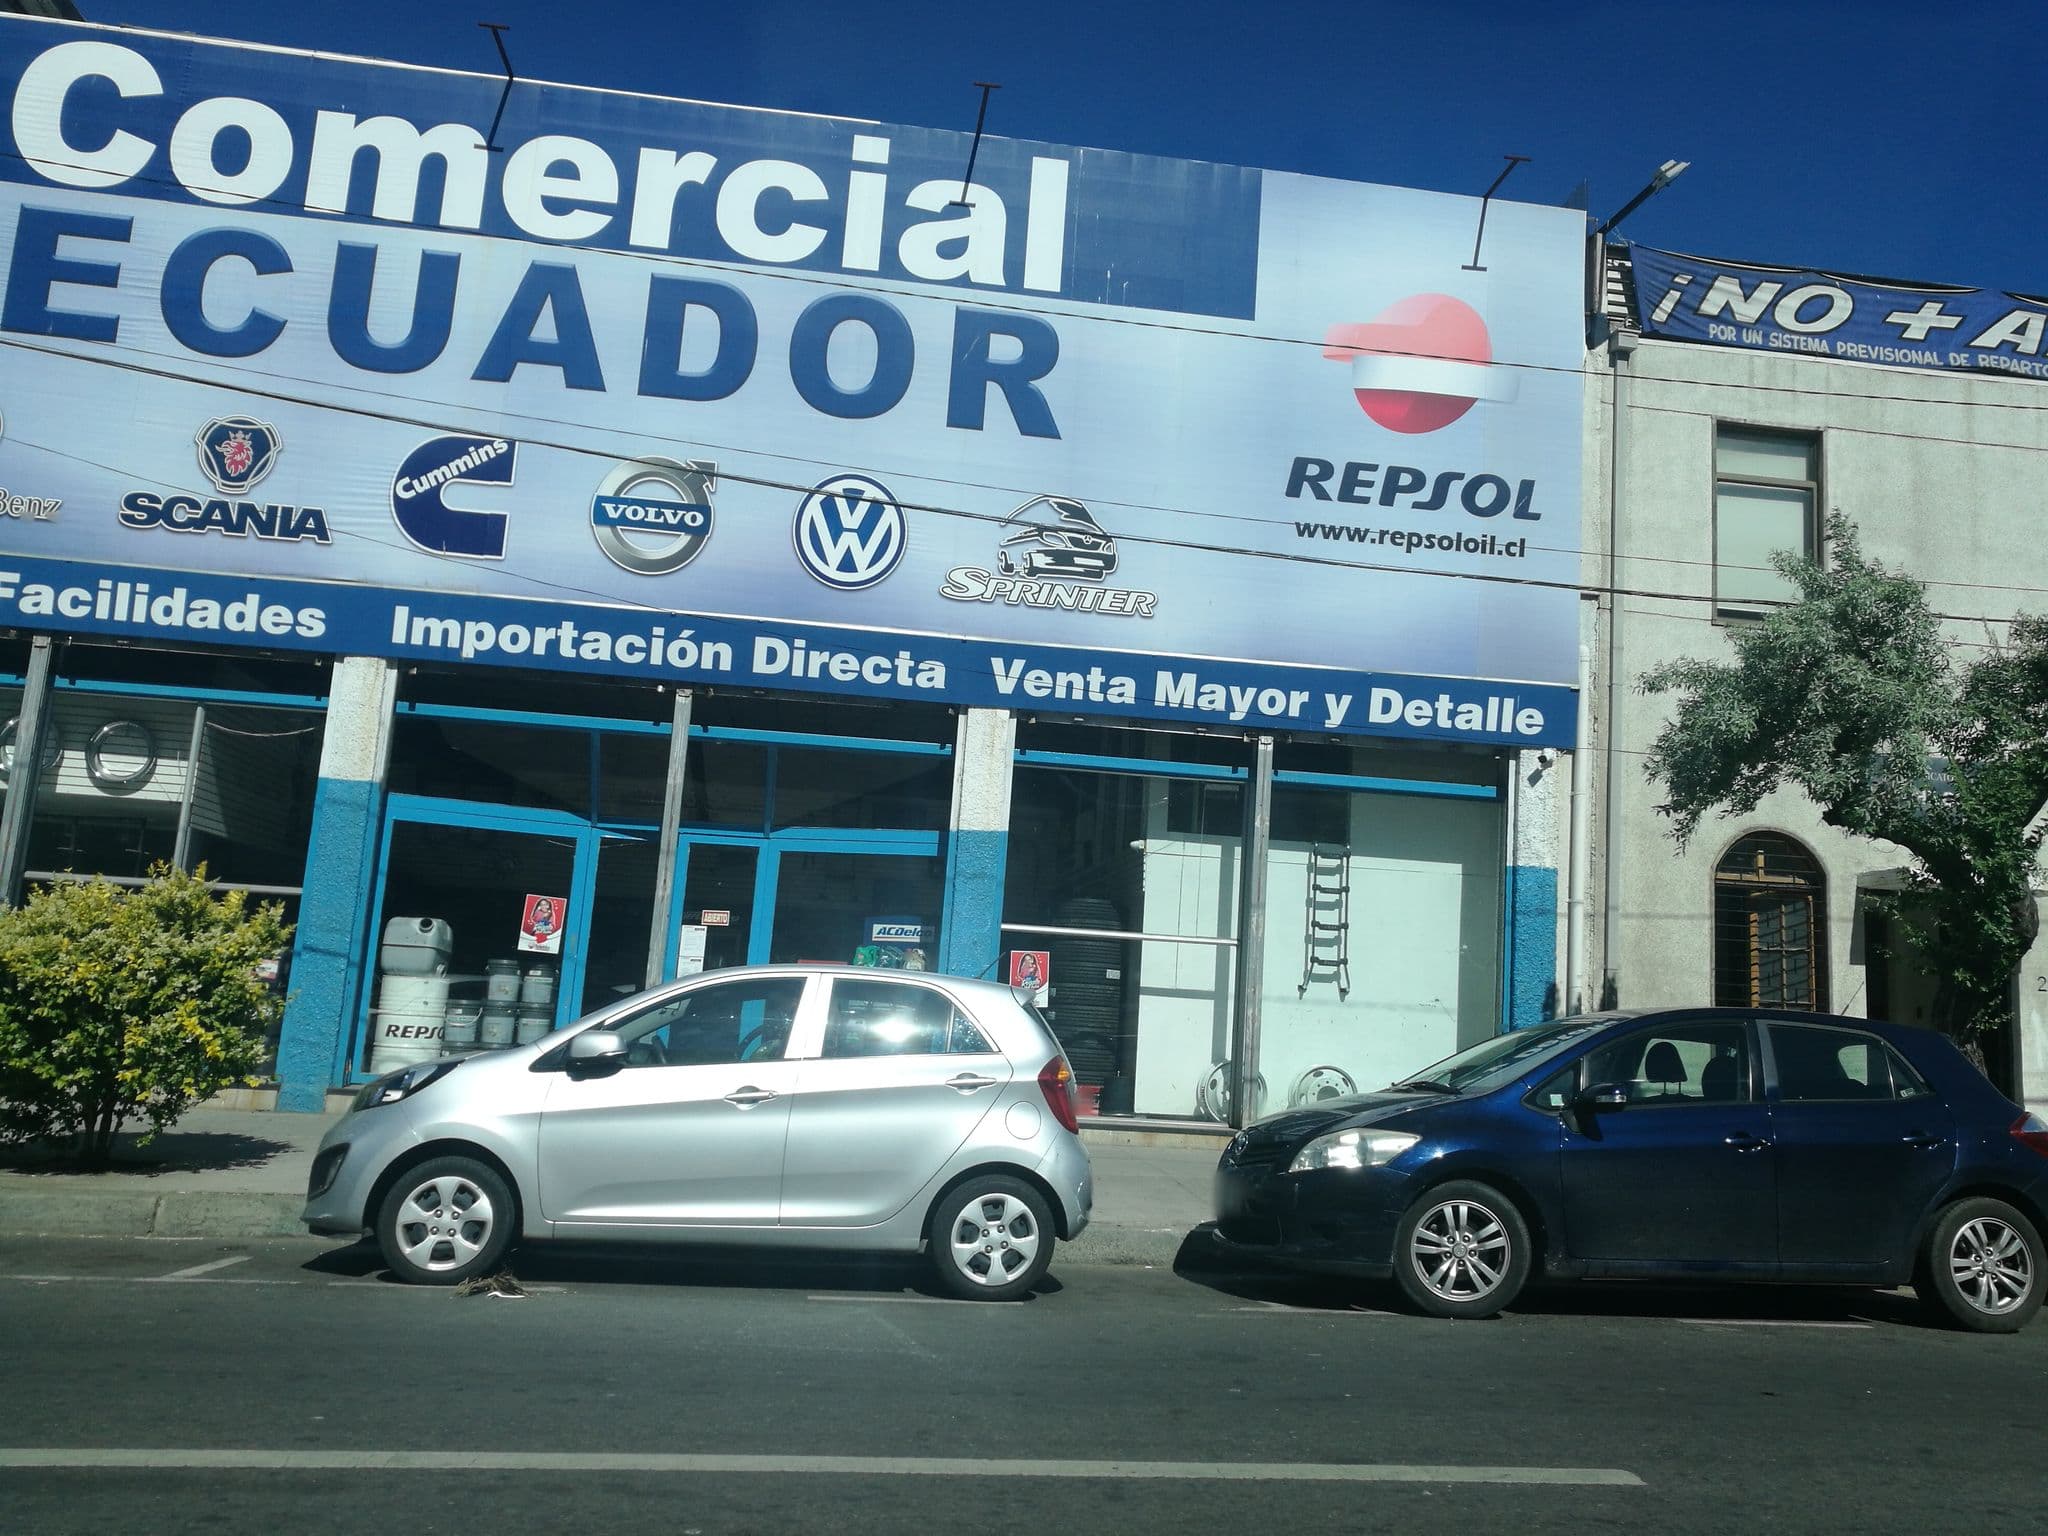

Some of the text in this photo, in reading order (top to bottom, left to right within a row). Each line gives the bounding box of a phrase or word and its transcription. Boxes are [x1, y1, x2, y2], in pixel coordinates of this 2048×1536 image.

[11, 40, 1070, 293] Comercial
[0, 202, 1062, 441] ECUADOR
[1709, 323, 1737, 341] POR
[1742, 328, 1763, 345] UN
[1769, 331, 1830, 355] SISTEMA
[1837, 341, 1944, 367] PREVISIONAL
[1950, 353, 1971, 369] DE
[396, 438, 509, 499] Cummins
[1285, 456, 1541, 521] REPSOL
[119, 492, 332, 545] SCANIA
[601, 503, 705, 528] VOLVO
[1296, 522, 1526, 559] www.repsoloil.cl
[0, 571, 326, 638] Facilidades
[939, 567, 1157, 618] SPRINTER
[392, 605, 946, 689] Importación Directa
[990, 657, 1545, 735] Venta Mayor y Detalle
[876, 926, 934, 937] ACDelco
